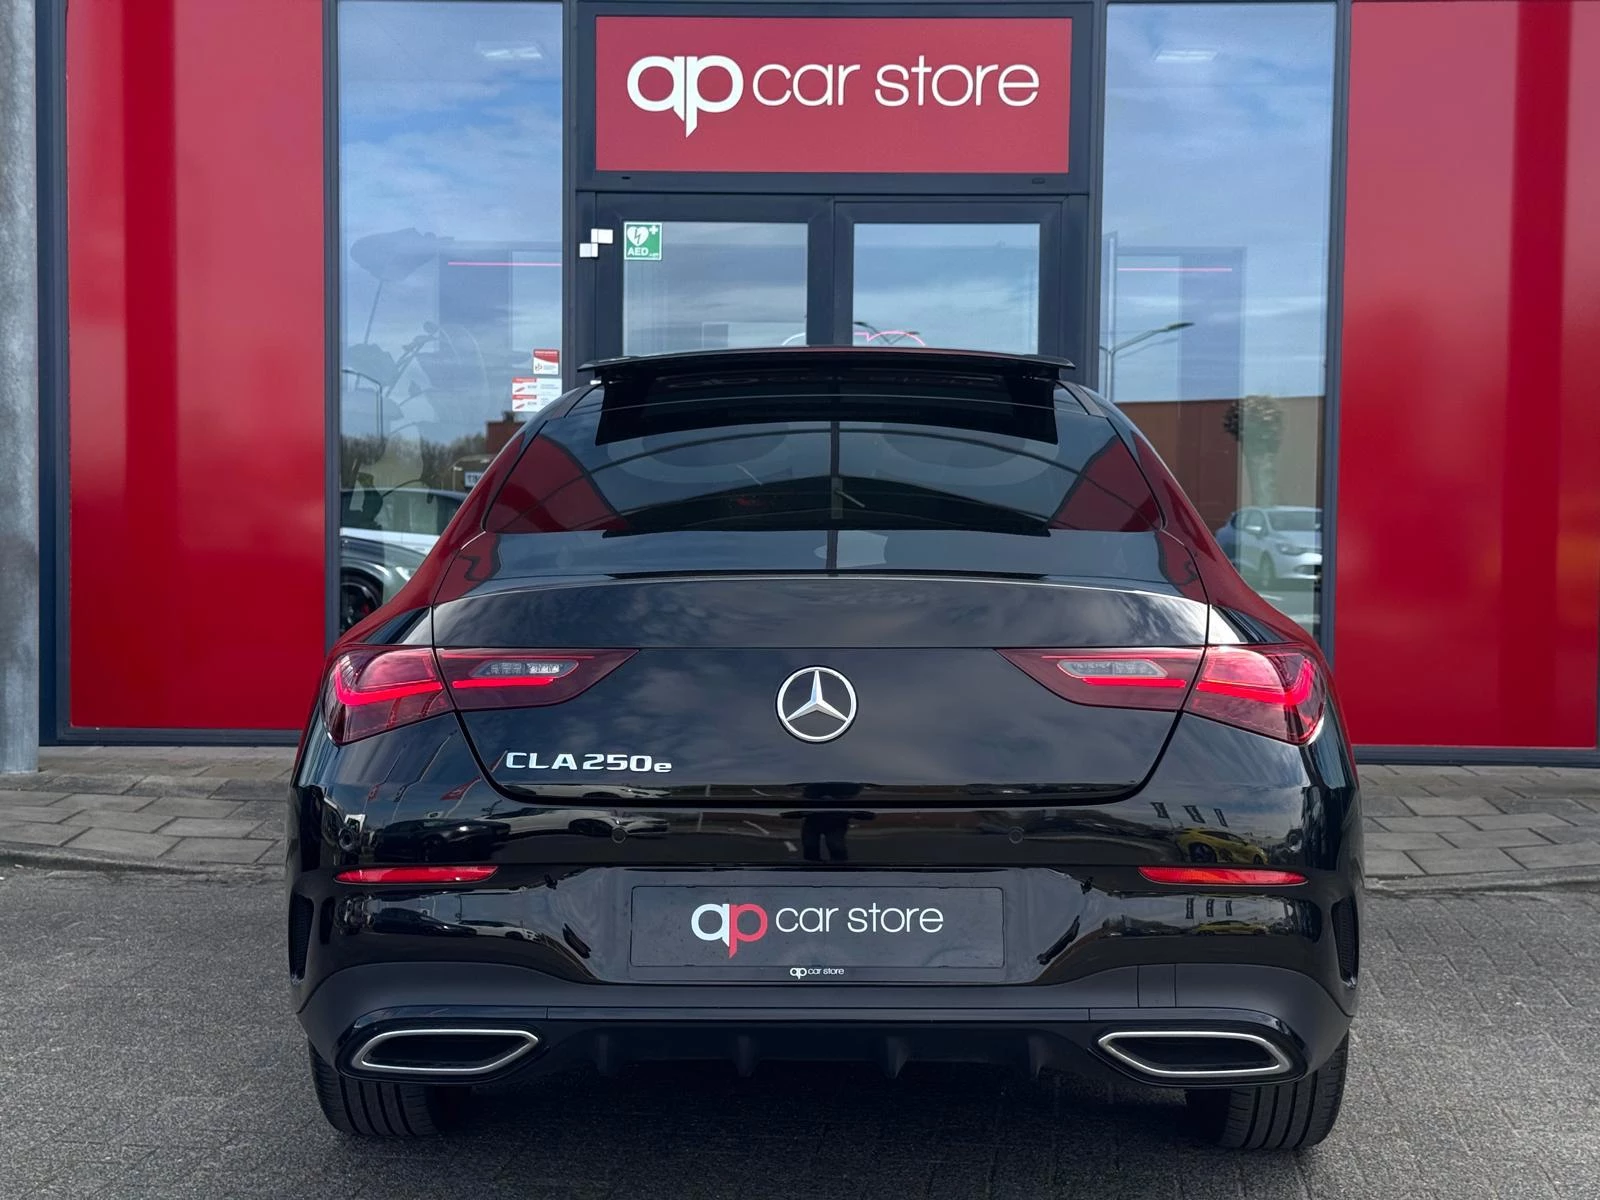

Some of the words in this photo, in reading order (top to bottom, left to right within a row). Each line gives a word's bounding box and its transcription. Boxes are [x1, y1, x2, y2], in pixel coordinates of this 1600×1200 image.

[752, 63, 861, 106] car
[874, 55, 1040, 107] store
[627, 247, 649, 257] AED
[775, 907, 839, 933] car
[847, 902, 944, 933] store
[823, 967, 845, 975] store
